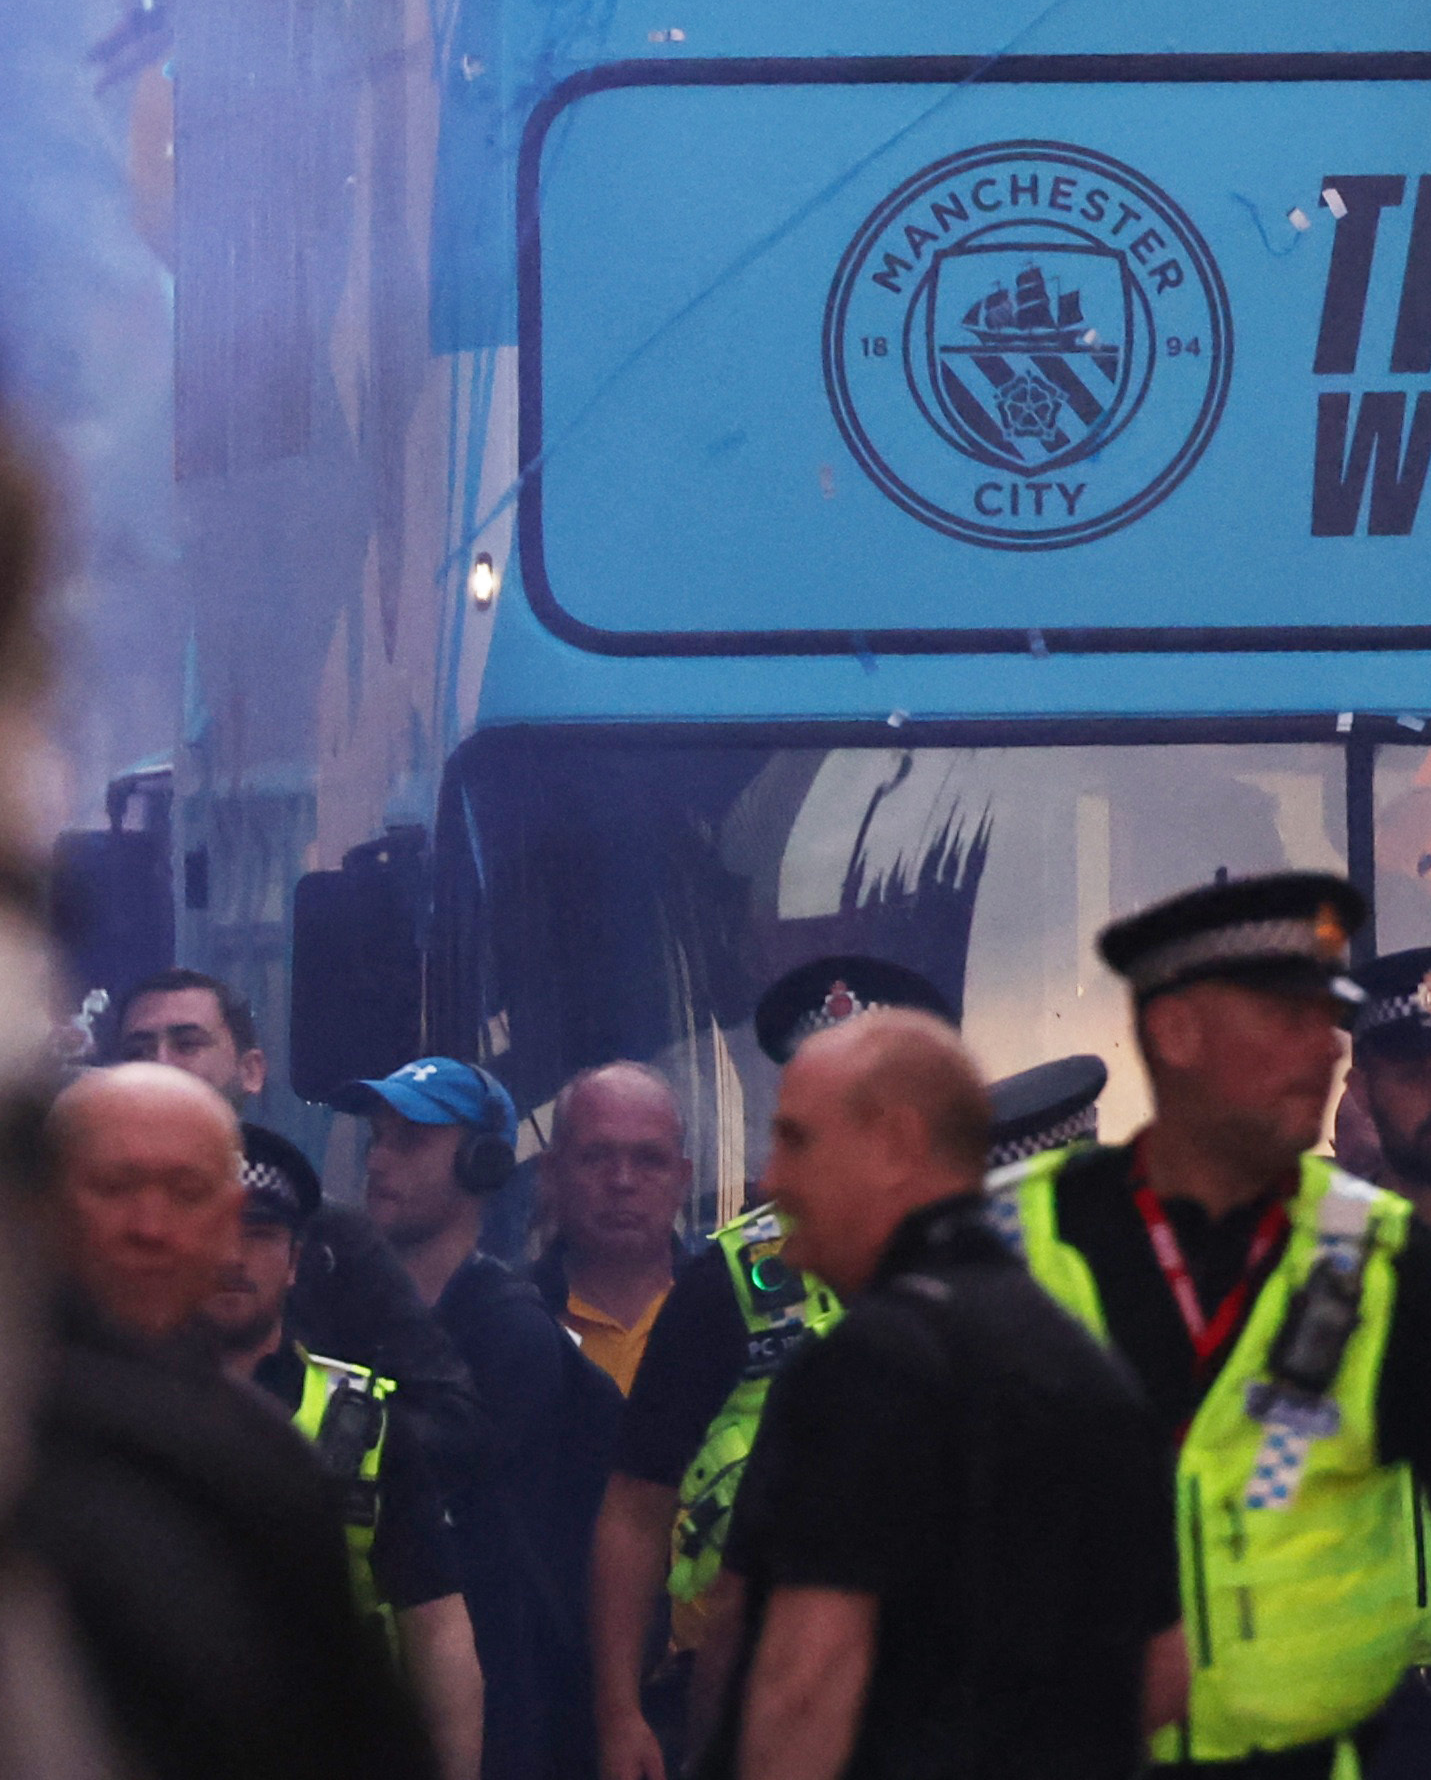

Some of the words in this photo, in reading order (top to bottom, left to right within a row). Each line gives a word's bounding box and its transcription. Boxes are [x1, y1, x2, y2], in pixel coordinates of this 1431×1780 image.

[872, 173, 1185, 295] MANCHESTER
[861, 337, 888, 357] 18
[1165, 336, 1202, 357] 94
[973, 481, 1086, 517] CITY
